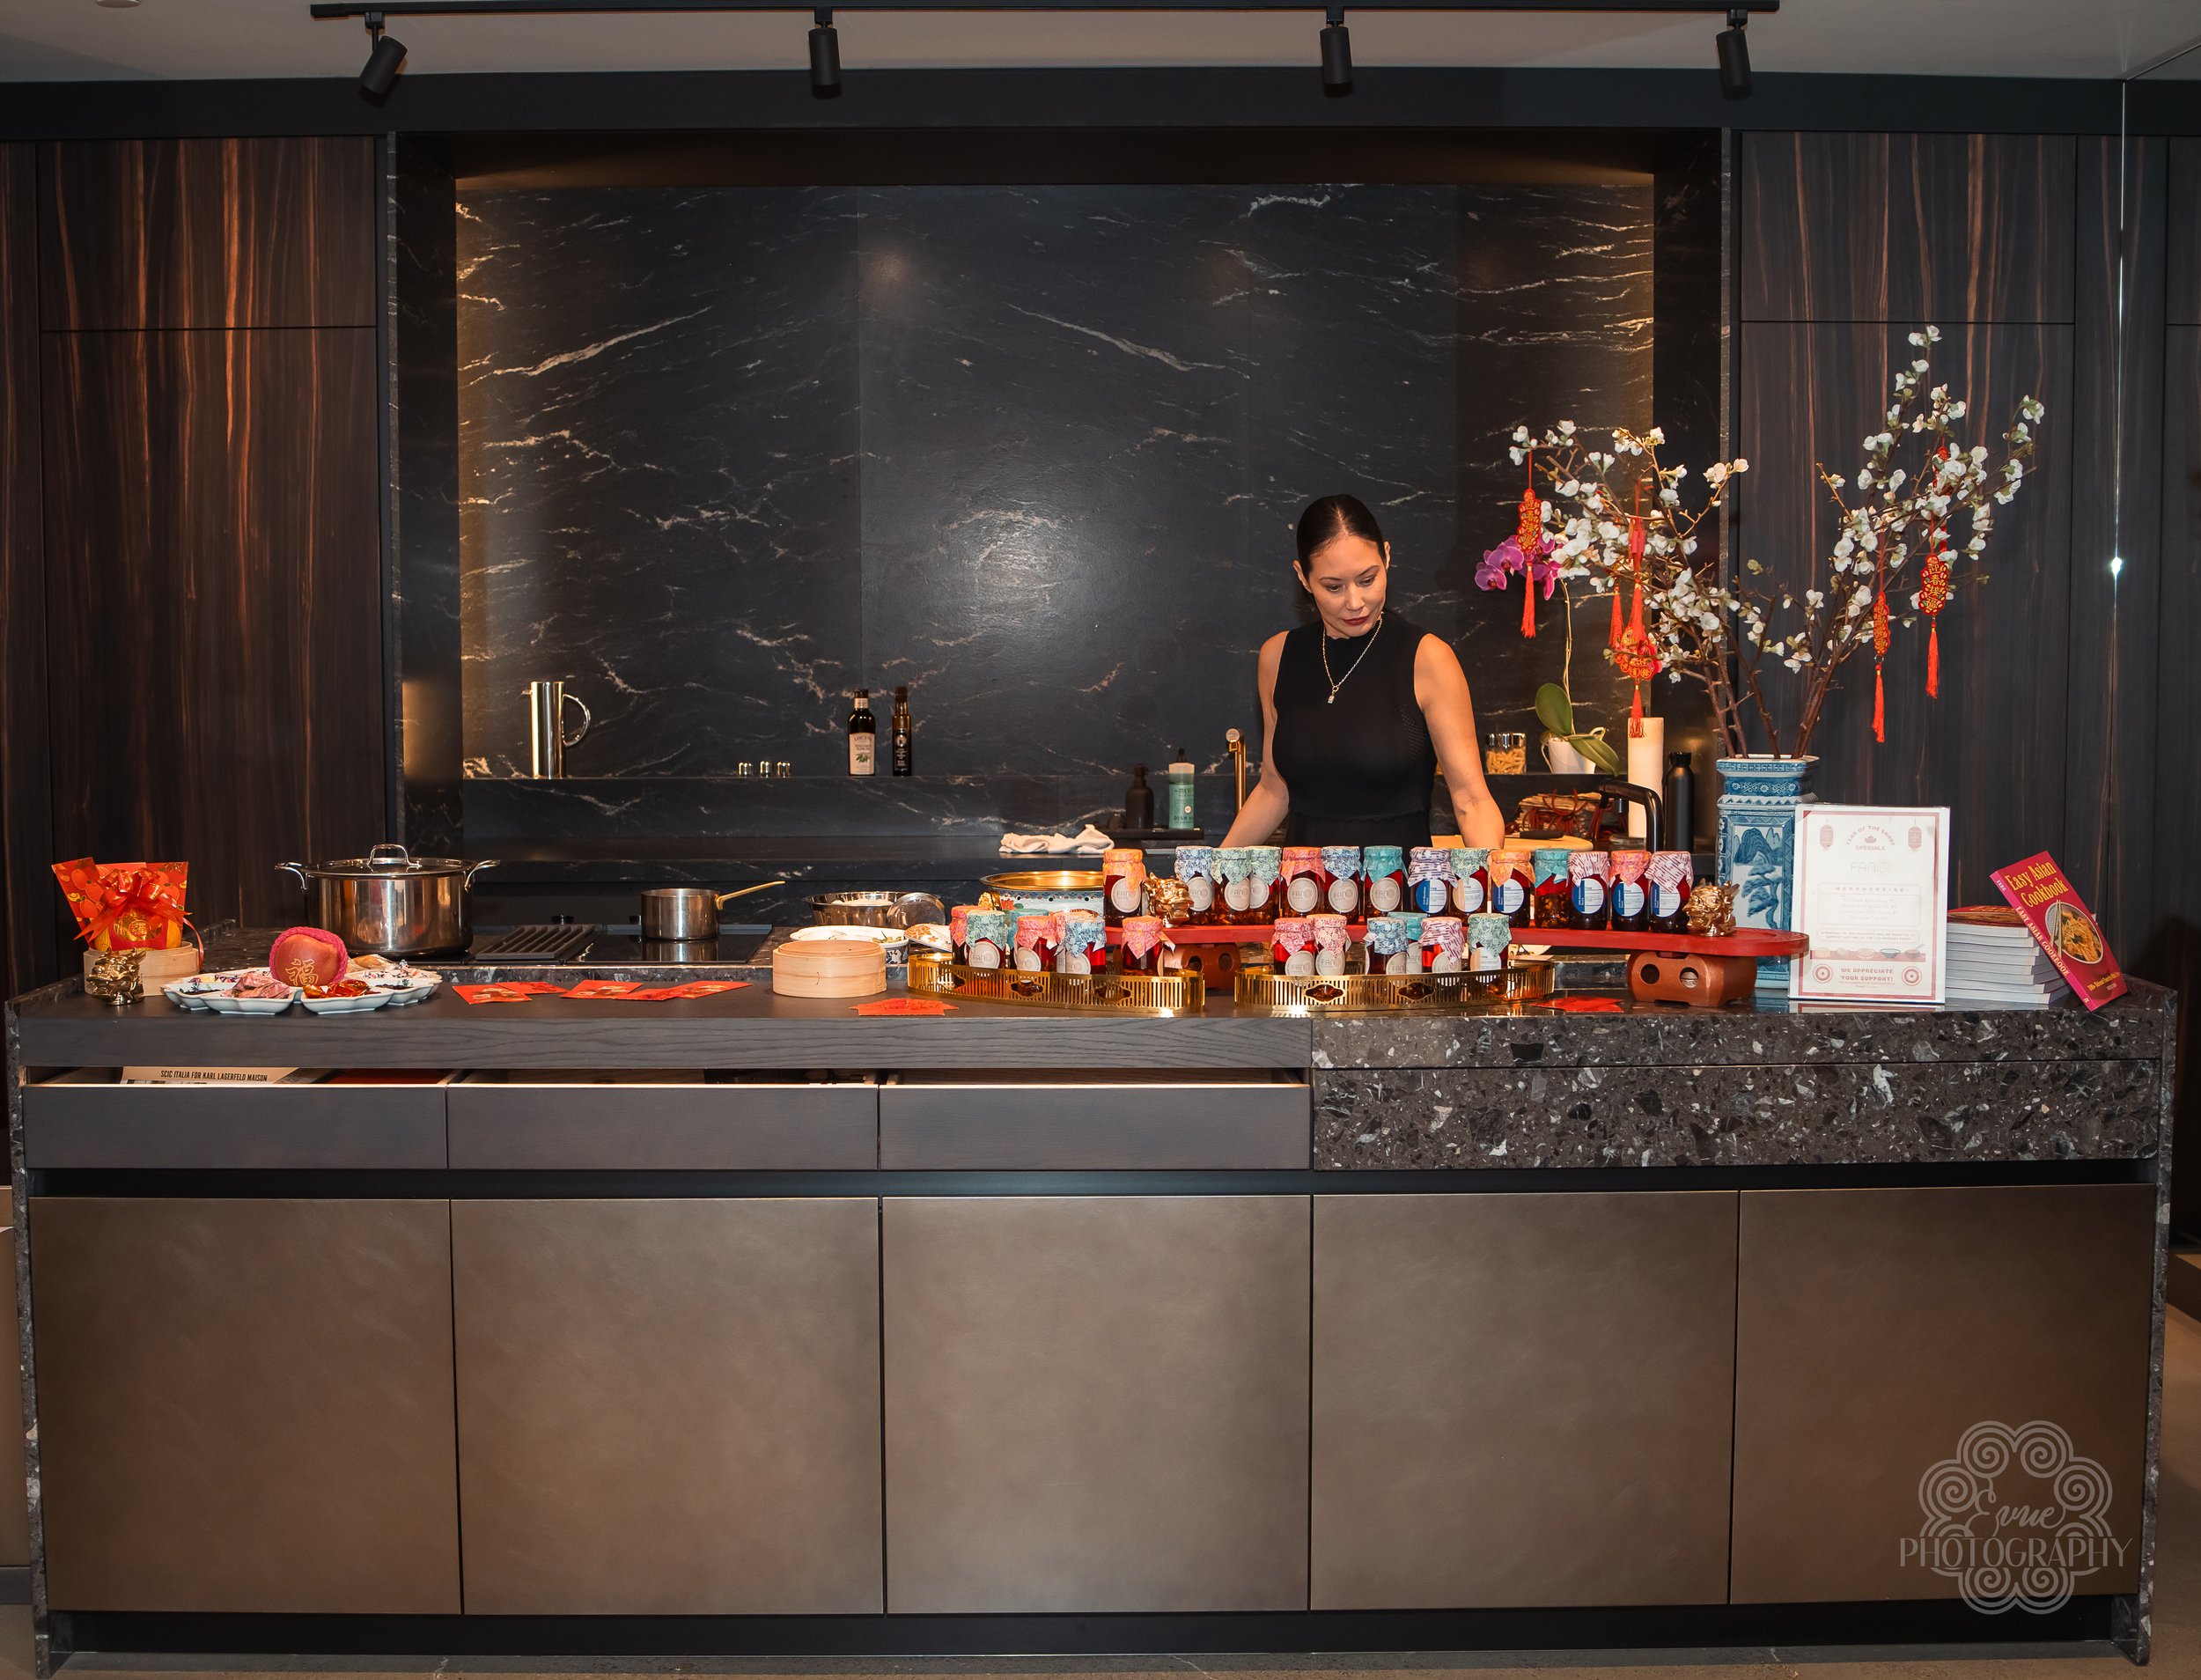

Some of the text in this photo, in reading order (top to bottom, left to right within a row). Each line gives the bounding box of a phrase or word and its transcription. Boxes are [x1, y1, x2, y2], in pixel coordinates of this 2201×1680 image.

[2005, 861, 2057, 891] Easy Asian
[2021, 877, 2069, 908] Cookbook
[2015, 905, 2070, 976] EASY ASIAN COOKBOOK
[285, 958, 318, 986] 福
[160, 1070, 173, 1079] SCIC
[191, 1071, 202, 1079] FOR
[217, 1072, 246, 1081] LAGERFELD
[247, 1073, 269, 1082] MAISON
